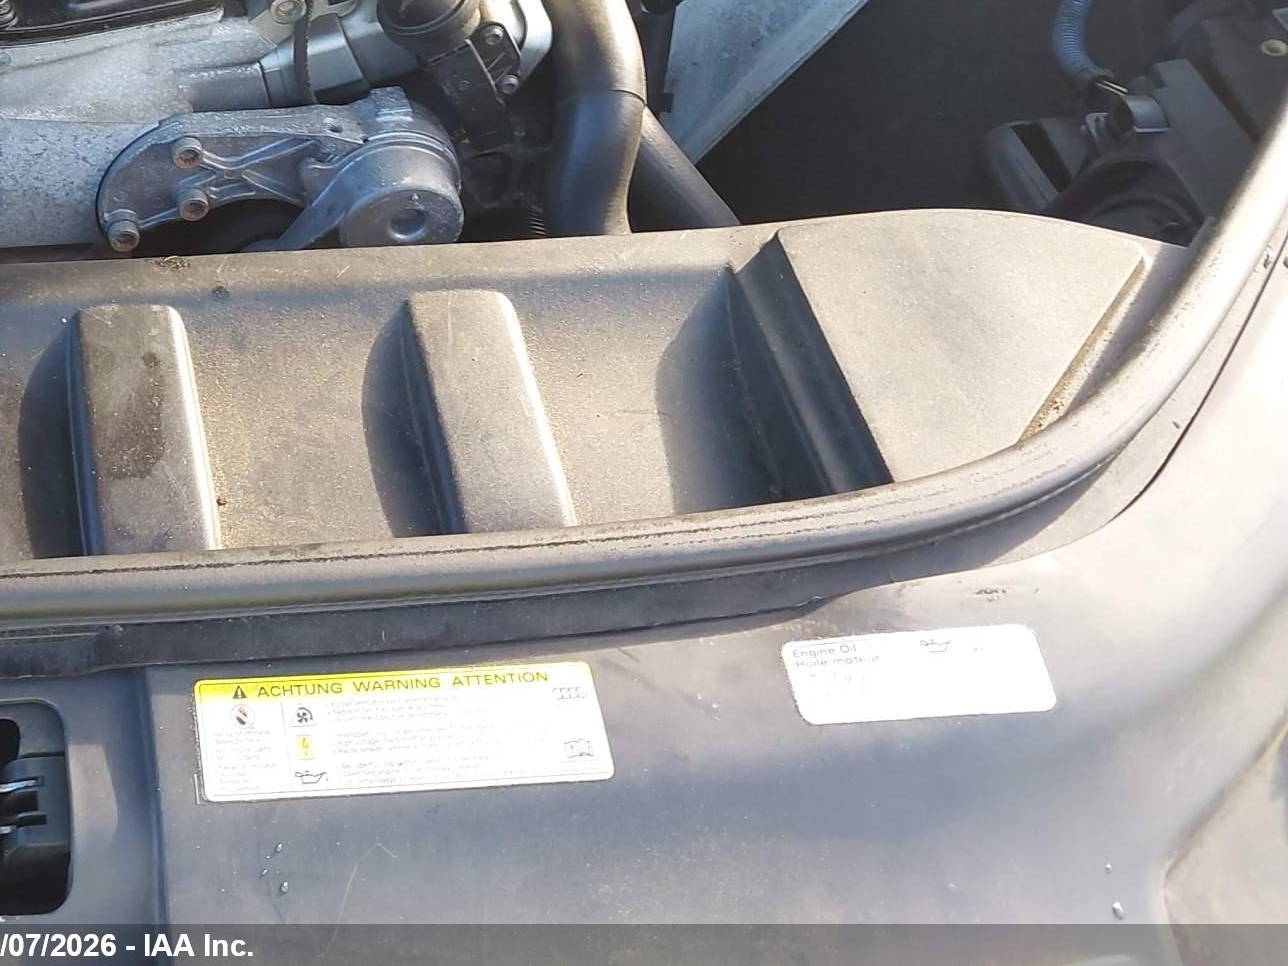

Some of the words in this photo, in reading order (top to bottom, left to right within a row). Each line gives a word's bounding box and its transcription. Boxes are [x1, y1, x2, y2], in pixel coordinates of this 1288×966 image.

[257, 682, 343, 698] ACHTUNG
[353, 677, 441, 692] WARNING
[452, 671, 549, 686] ATTENTION
